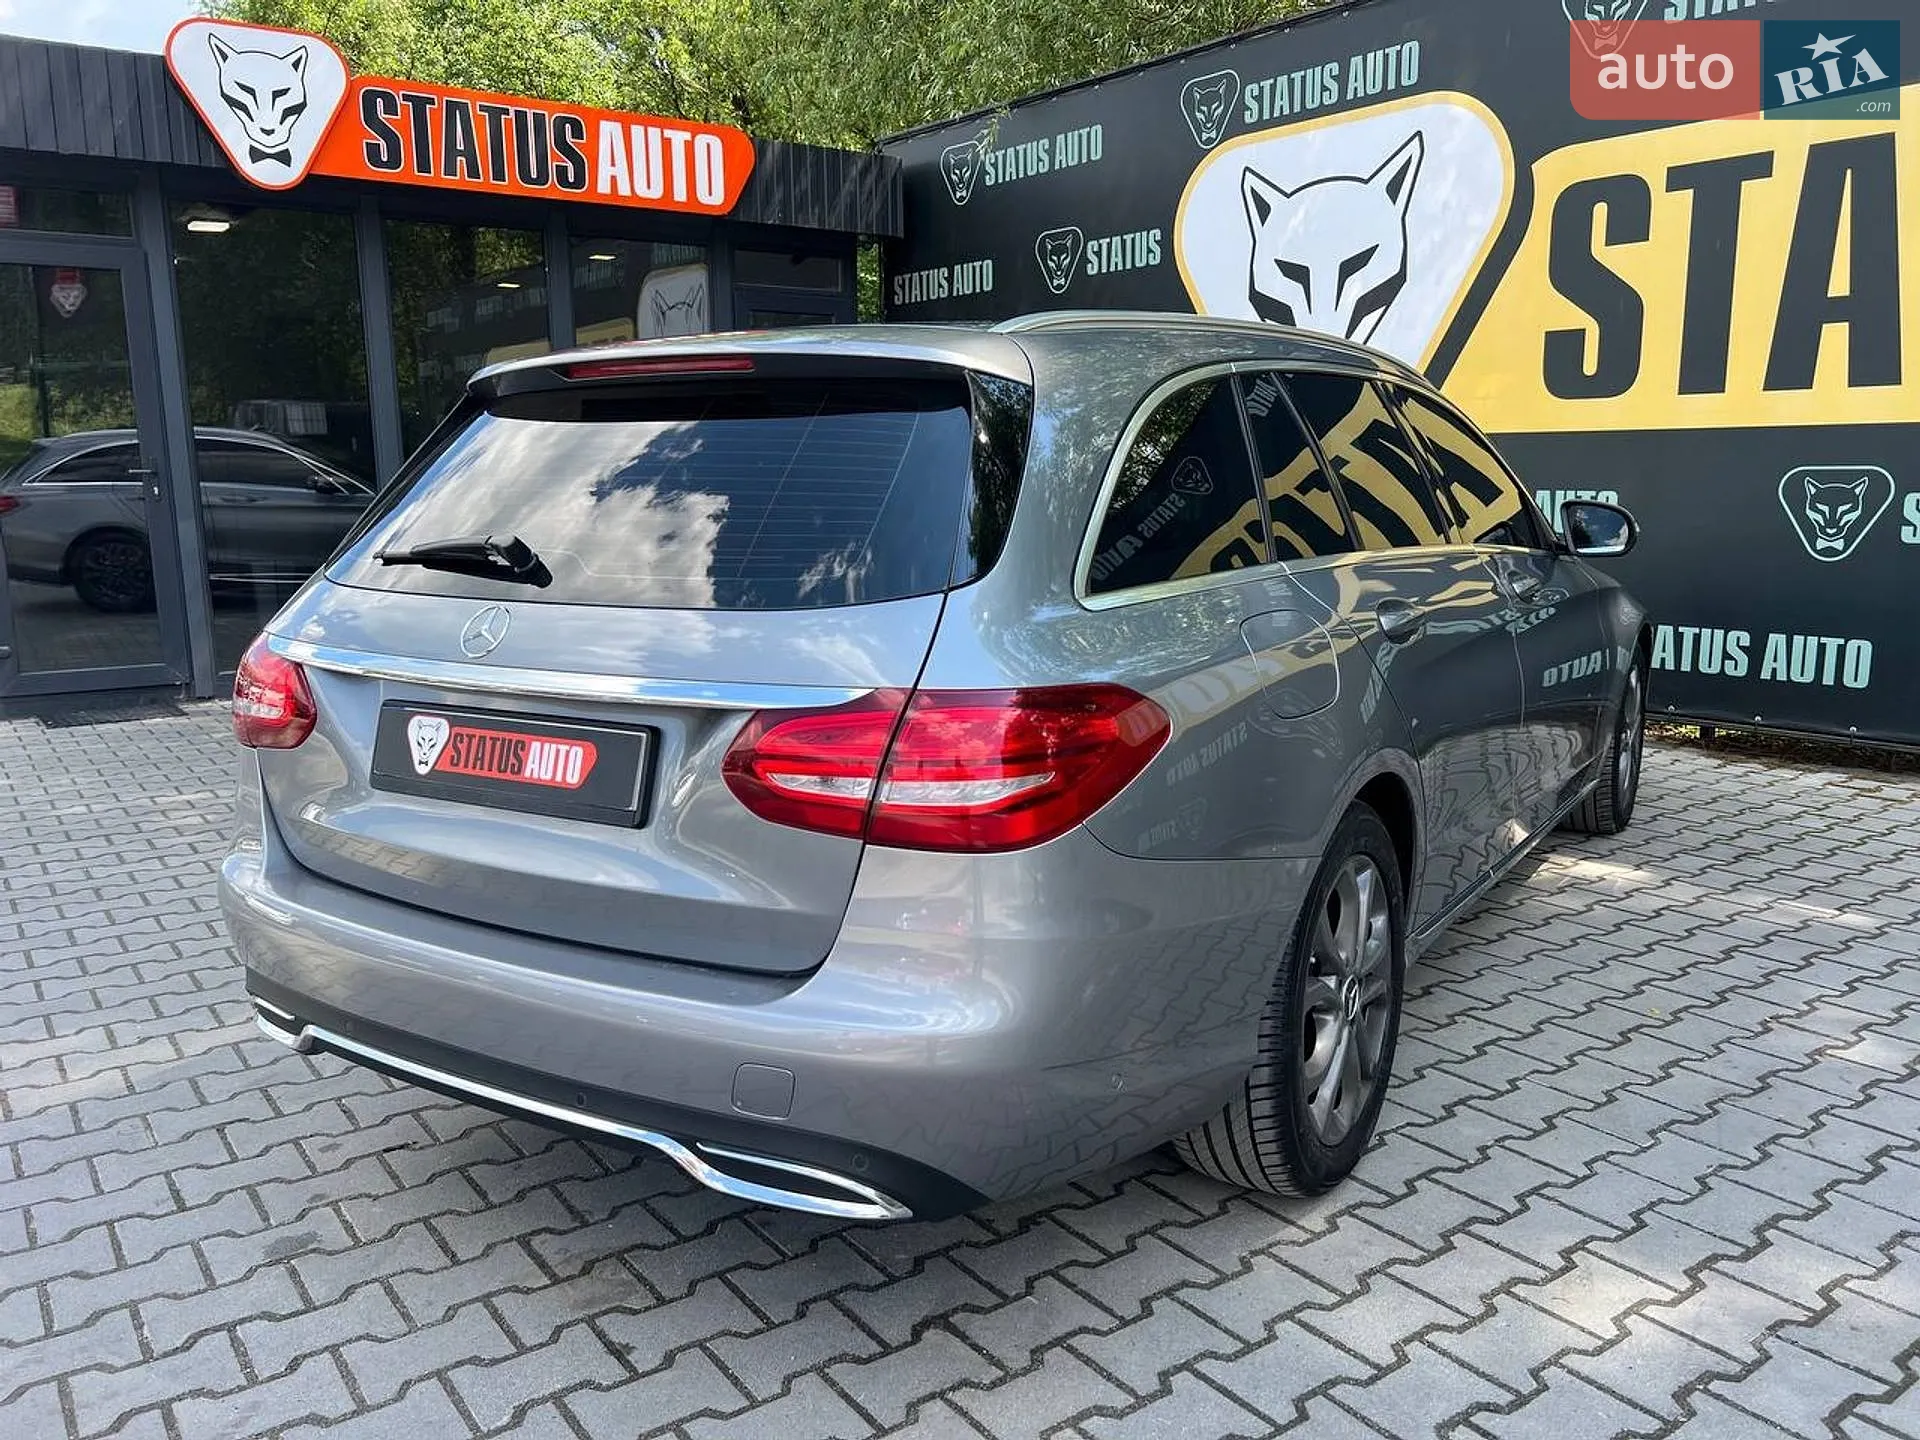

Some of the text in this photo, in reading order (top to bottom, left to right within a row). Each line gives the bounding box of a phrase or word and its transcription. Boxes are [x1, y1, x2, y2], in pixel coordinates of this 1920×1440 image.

[1244, 40, 1420, 124] STATUS AUTO
[360, 87, 726, 207] STATUS AUTO
[984, 124, 1103, 186] STATUS AUTO
[1086, 228, 1161, 276] STATUS
[893, 259, 993, 306] STATUS AUTO
[1760, 632, 1874, 689] AUTO
[450, 732, 583, 785] STATUS AUTO
